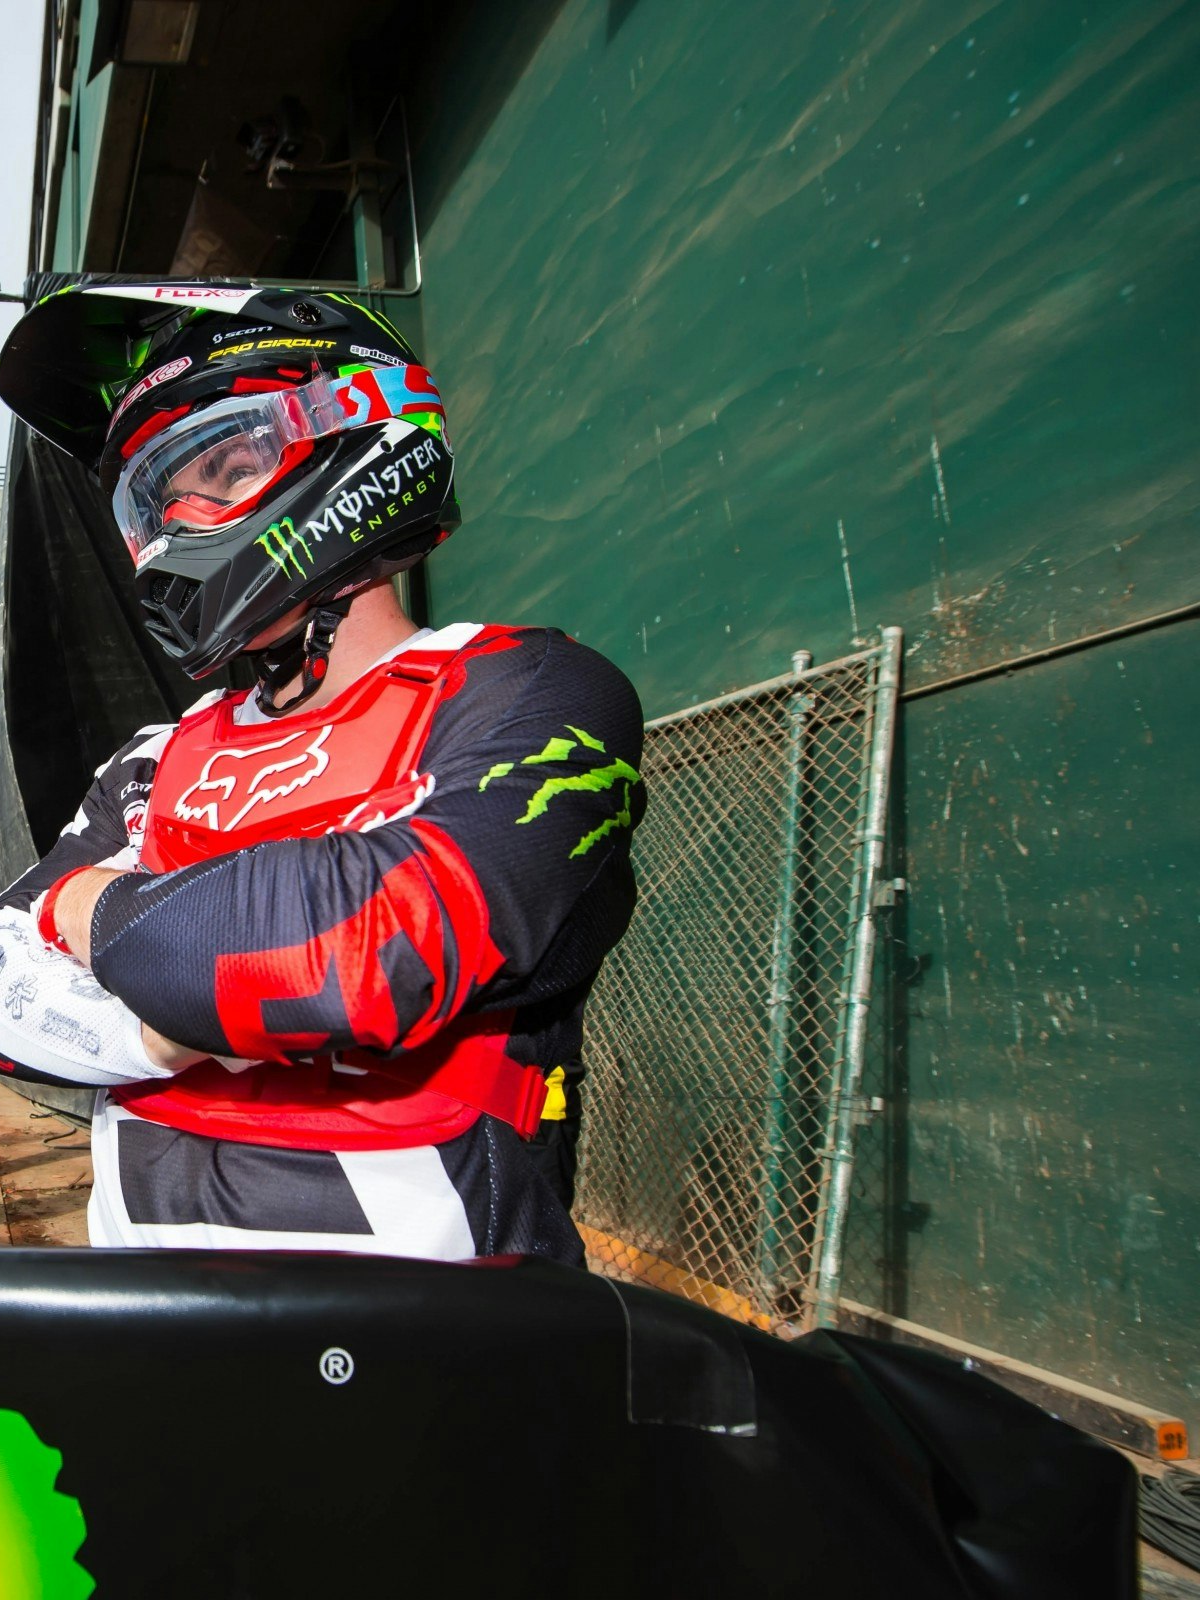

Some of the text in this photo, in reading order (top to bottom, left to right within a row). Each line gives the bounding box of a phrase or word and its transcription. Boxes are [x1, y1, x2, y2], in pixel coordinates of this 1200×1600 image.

[207, 338, 337, 361] PRO CIRCUIT
[306, 437, 441, 542] MONSTER
[349, 471, 437, 543] ENERGY
